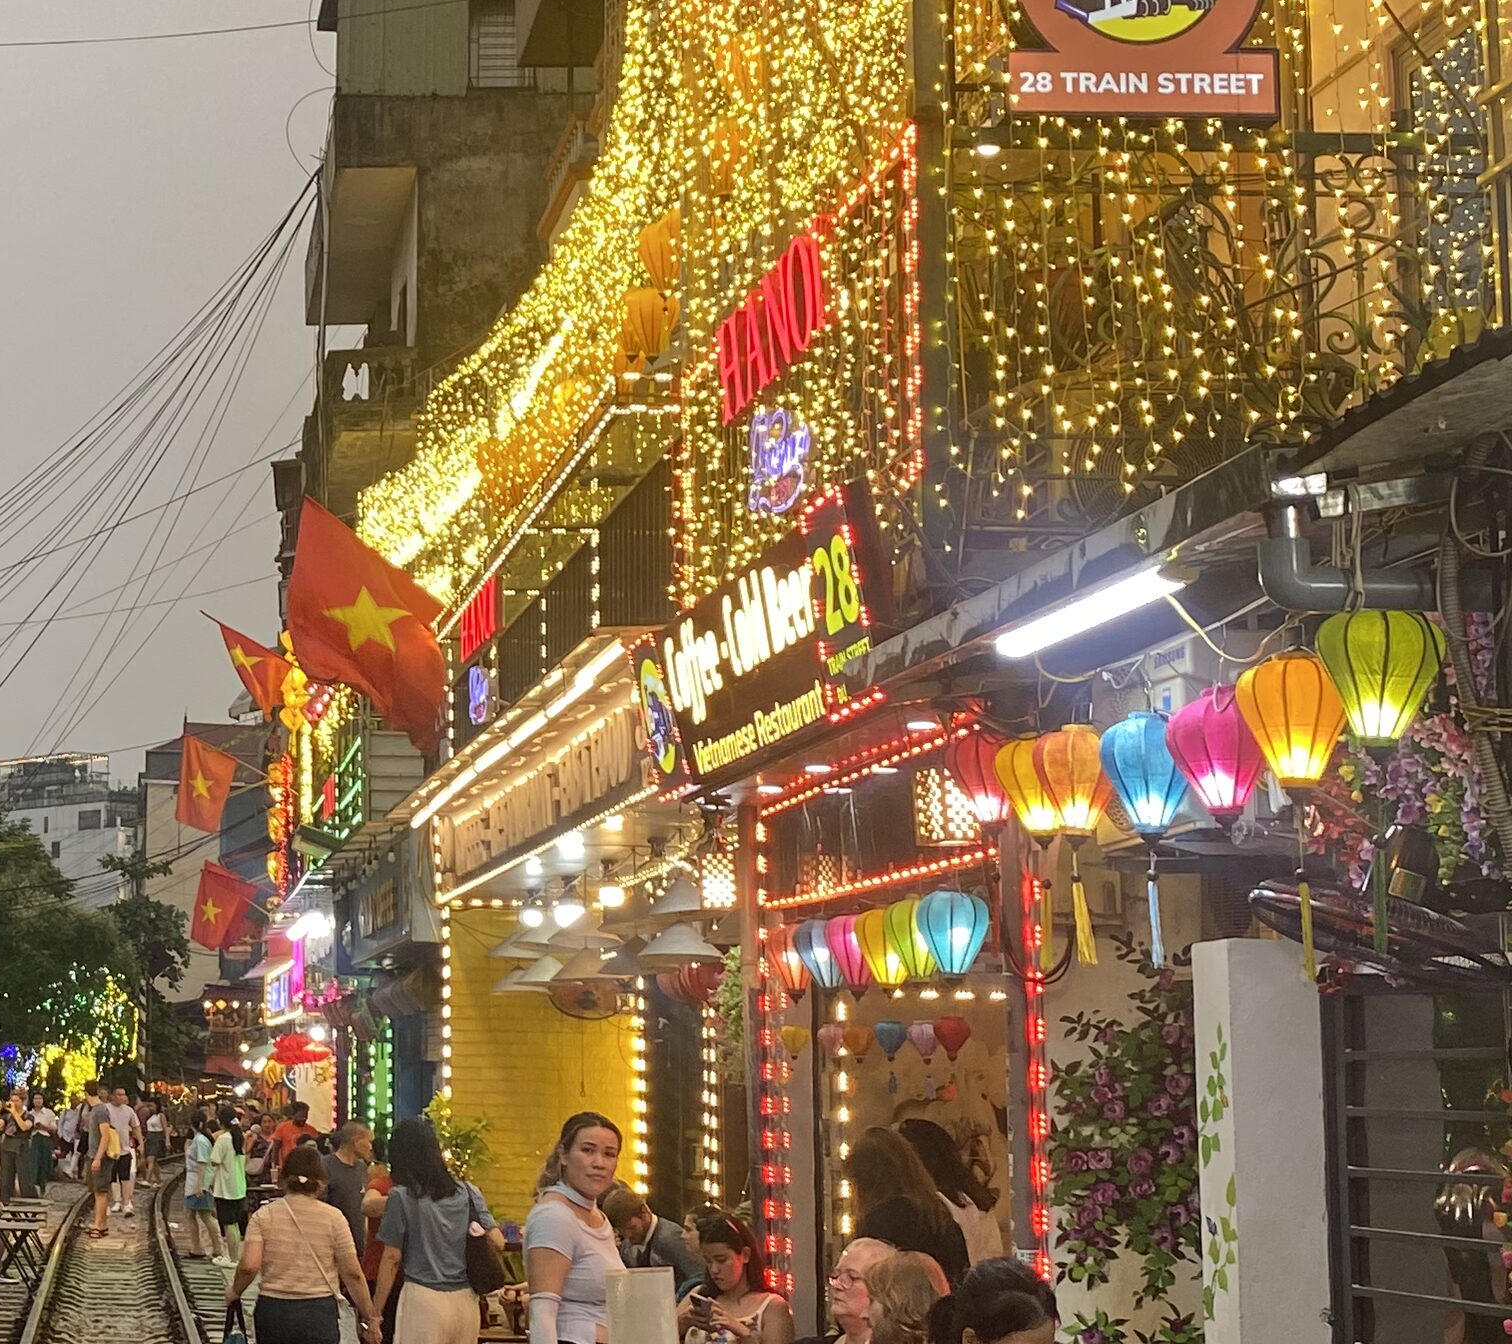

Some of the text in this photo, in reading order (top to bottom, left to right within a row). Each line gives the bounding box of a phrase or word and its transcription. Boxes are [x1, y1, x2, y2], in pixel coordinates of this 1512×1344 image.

[1019, 71, 1263, 94] 28 TRAIN STREET
[716, 233, 826, 427] HANOI
[761, 566, 815, 654] Beer
[813, 534, 859, 636] 28
[1154, 646, 1185, 669] SAMSUNG
[692, 722, 758, 775] Vietnamese
[754, 679, 826, 747] Restaurant
